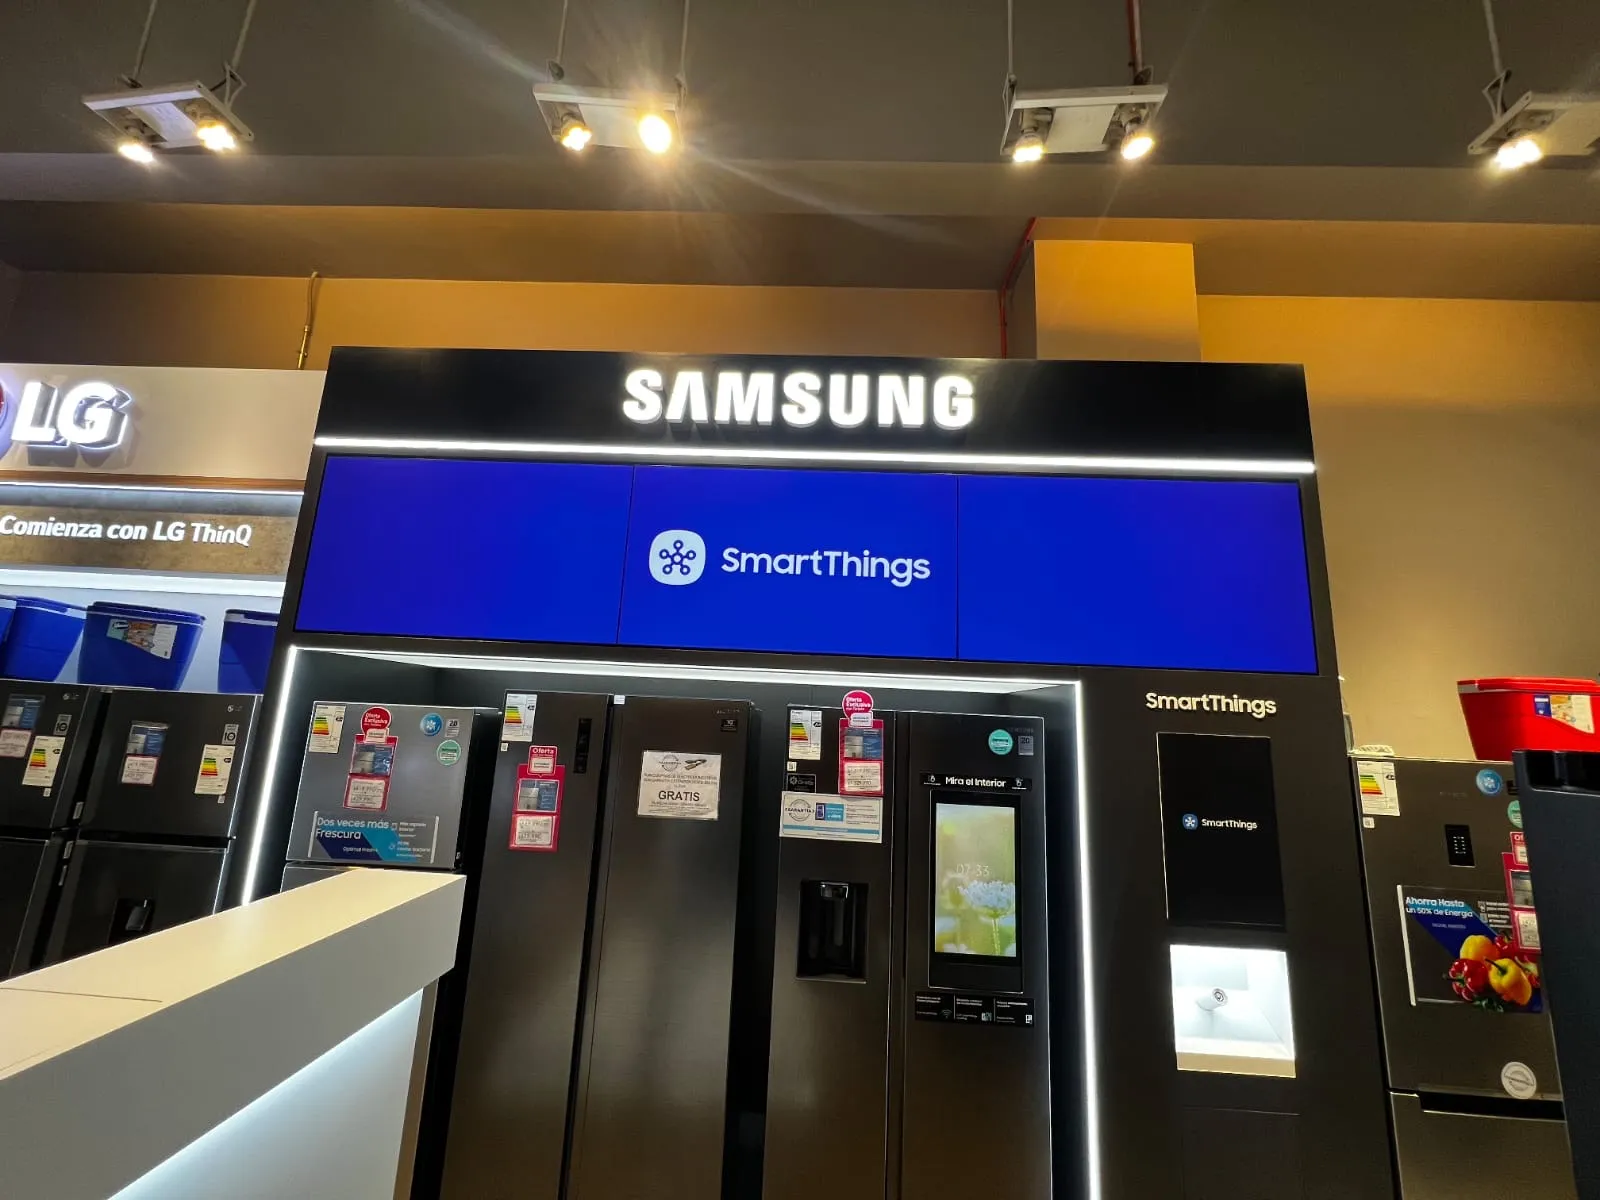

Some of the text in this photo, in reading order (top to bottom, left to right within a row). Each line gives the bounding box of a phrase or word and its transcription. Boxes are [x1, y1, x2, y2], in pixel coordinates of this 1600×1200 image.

[622, 368, 975, 430] SAMSUNG
[11, 381, 127, 447] LG
[0, 515, 252, 547] Comienza con LG ThinQ
[721, 547, 931, 587] SmartThings
[1145, 692, 1277, 719] SmartThings
[945, 777, 964, 786] Mira
[965, 778, 974, 786] el
[975, 778, 1006, 788] Interior
[658, 790, 701, 802] GRATIS
[316, 817, 335, 827] Dos
[337, 819, 366, 828] veces
[367, 819, 390, 830] más
[1201, 818, 1258, 831] SmartThings
[315, 828, 362, 840] Frescura
[1405, 896, 1465, 908] Ahorra Hasta
[1433, 908, 1443, 916] de
